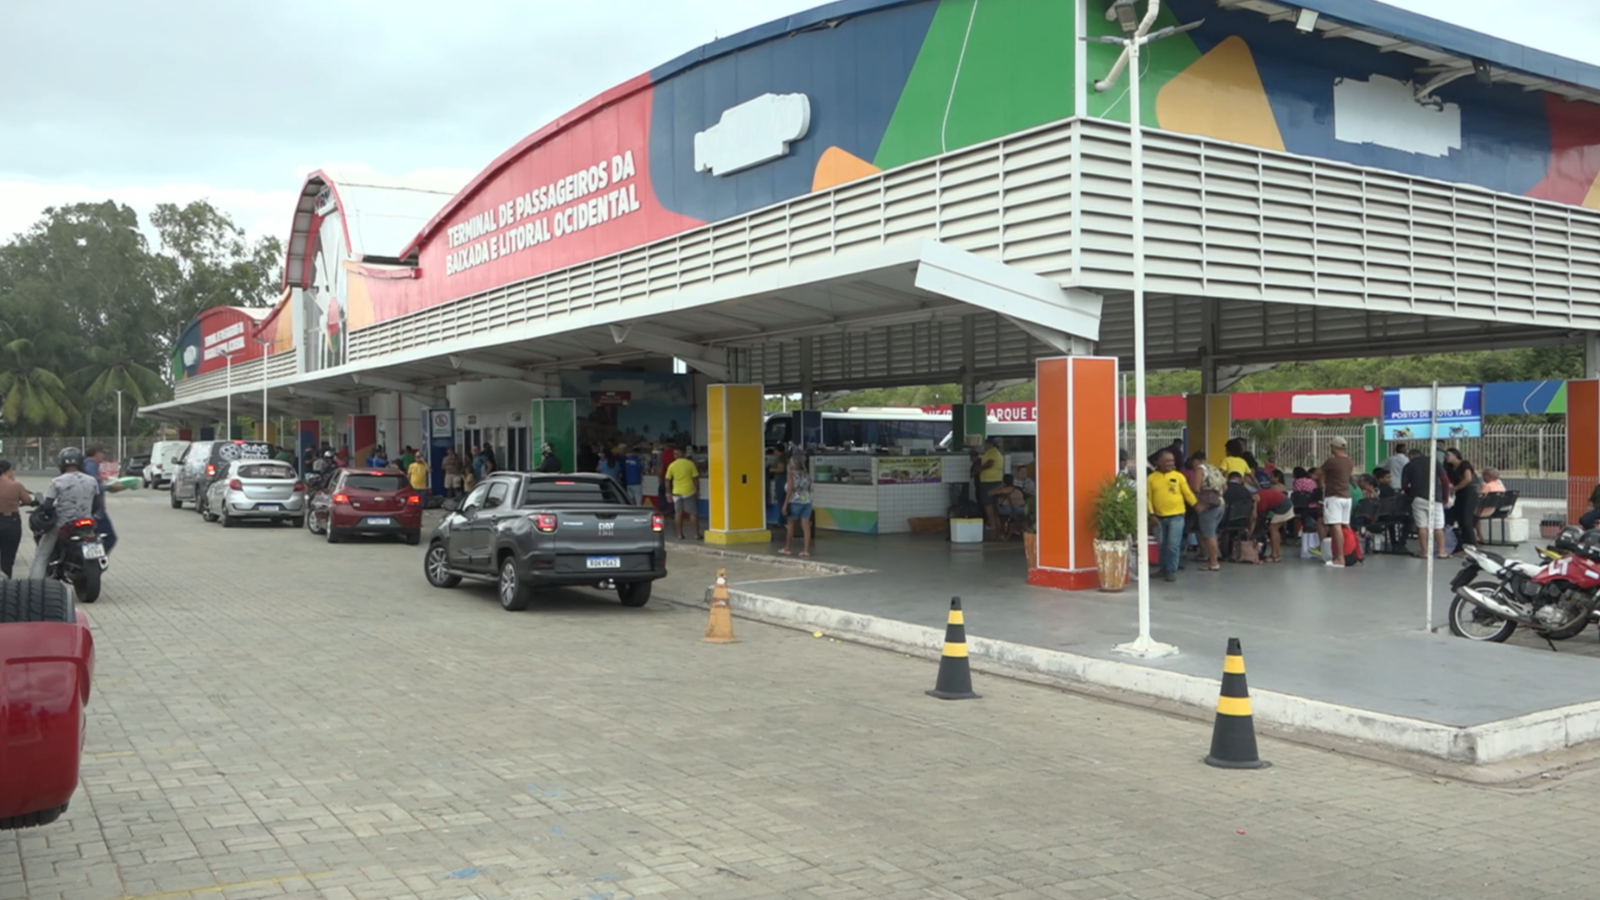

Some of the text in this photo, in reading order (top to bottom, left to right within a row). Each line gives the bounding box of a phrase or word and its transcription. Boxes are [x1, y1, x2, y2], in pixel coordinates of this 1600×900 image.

[446, 184, 640, 276] BAIXADA E LITORAL OCIDENTAL
[447, 150, 635, 249] TERMINAL DE PASSAGEIROS DA
[1391, 411, 1418, 419] POSTO
[1419, 410, 1429, 418] DE
[1436, 409, 1454, 417] OTO
